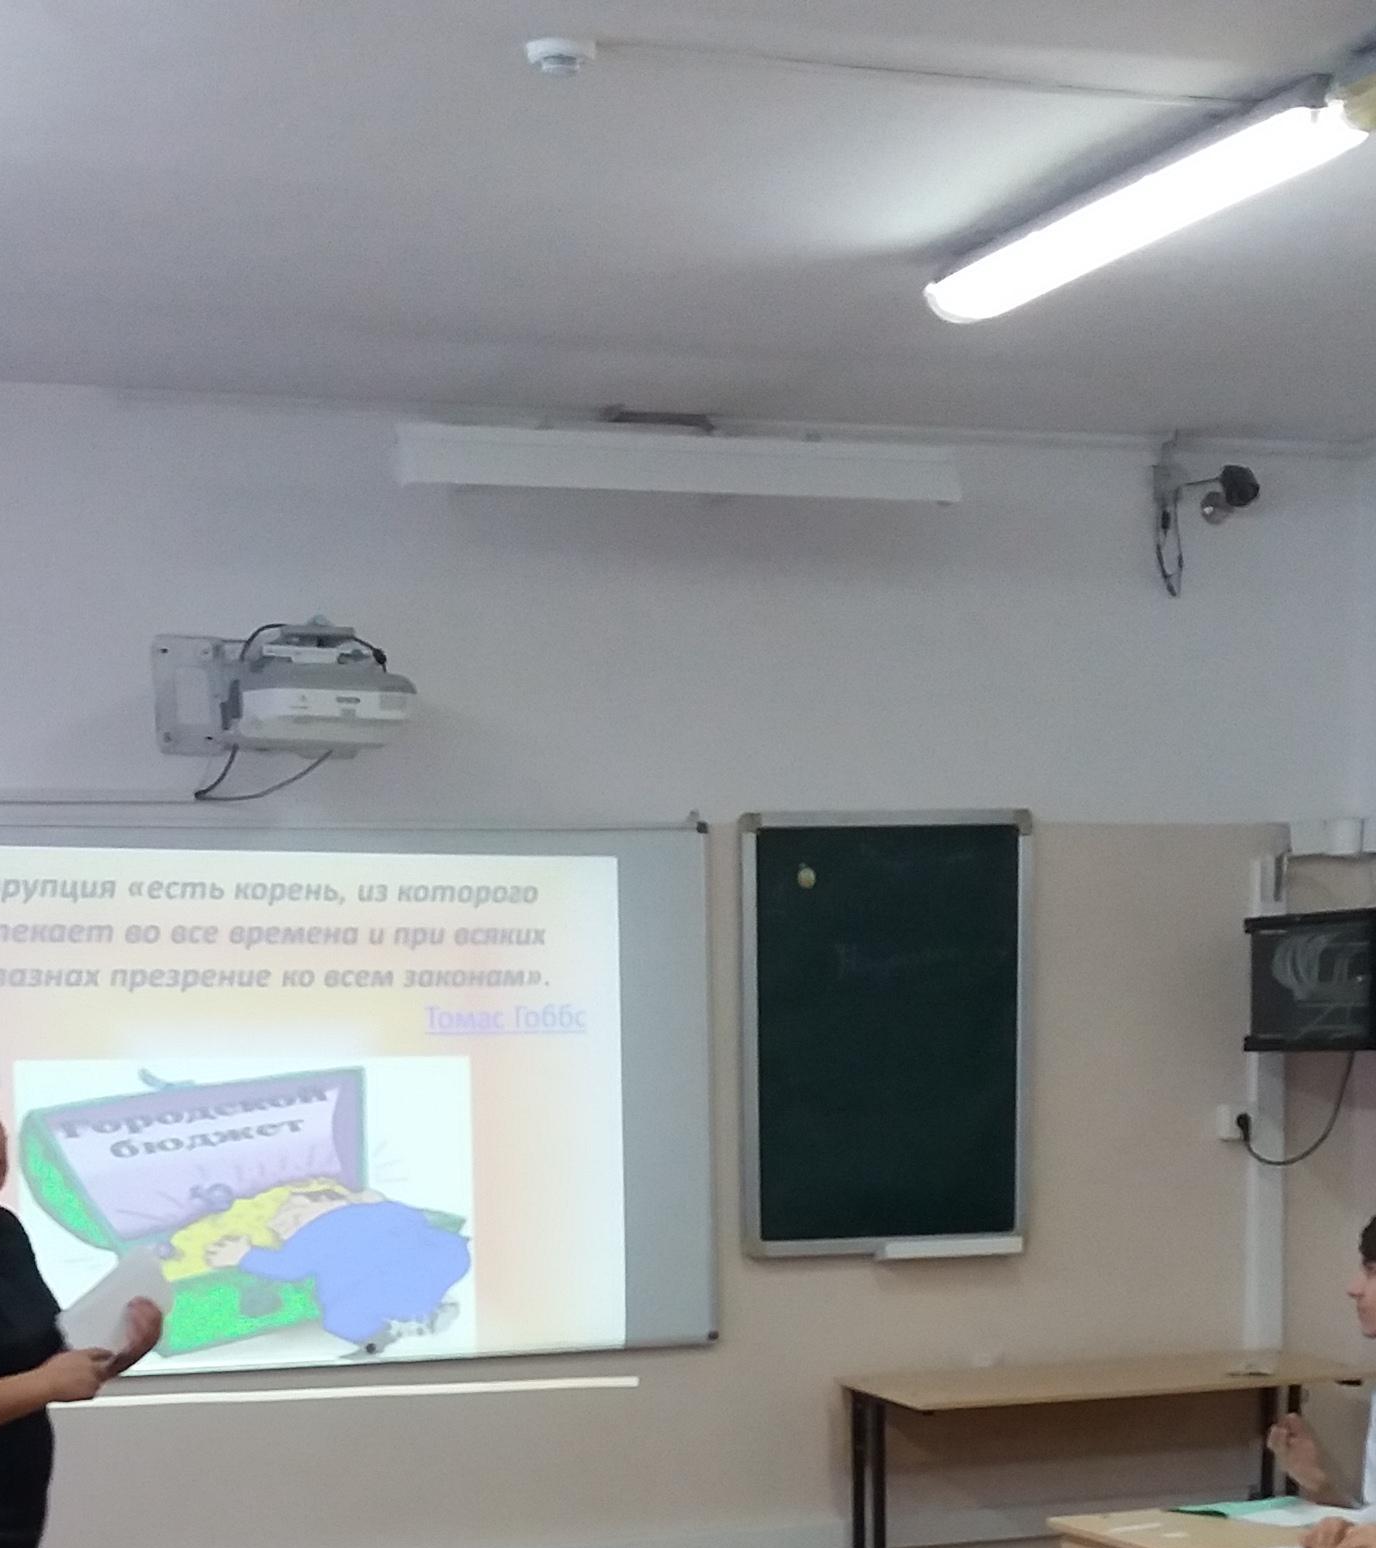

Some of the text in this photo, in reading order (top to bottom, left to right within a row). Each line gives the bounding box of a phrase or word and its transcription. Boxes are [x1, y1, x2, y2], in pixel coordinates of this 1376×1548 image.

[128, 879, 224, 900] «есть
[233, 880, 346, 906] корень,
[357, 884, 388, 902] из
[397, 883, 538, 907] которого
[124, 924, 161, 944] во
[171, 924, 218, 944] все
[229, 925, 358, 949] времена
[369, 928, 384, 945] и
[393, 926, 444, 949] при
[454, 927, 546, 946] всяких
[110, 967, 272, 992] презрение
[281, 969, 315, 988] ко
[324, 969, 394, 988] всем
[403, 969, 551, 988] законам».
[426, 1003, 587, 1030] Томас Гоббс
[110, 1119, 304, 1158] бюджет
